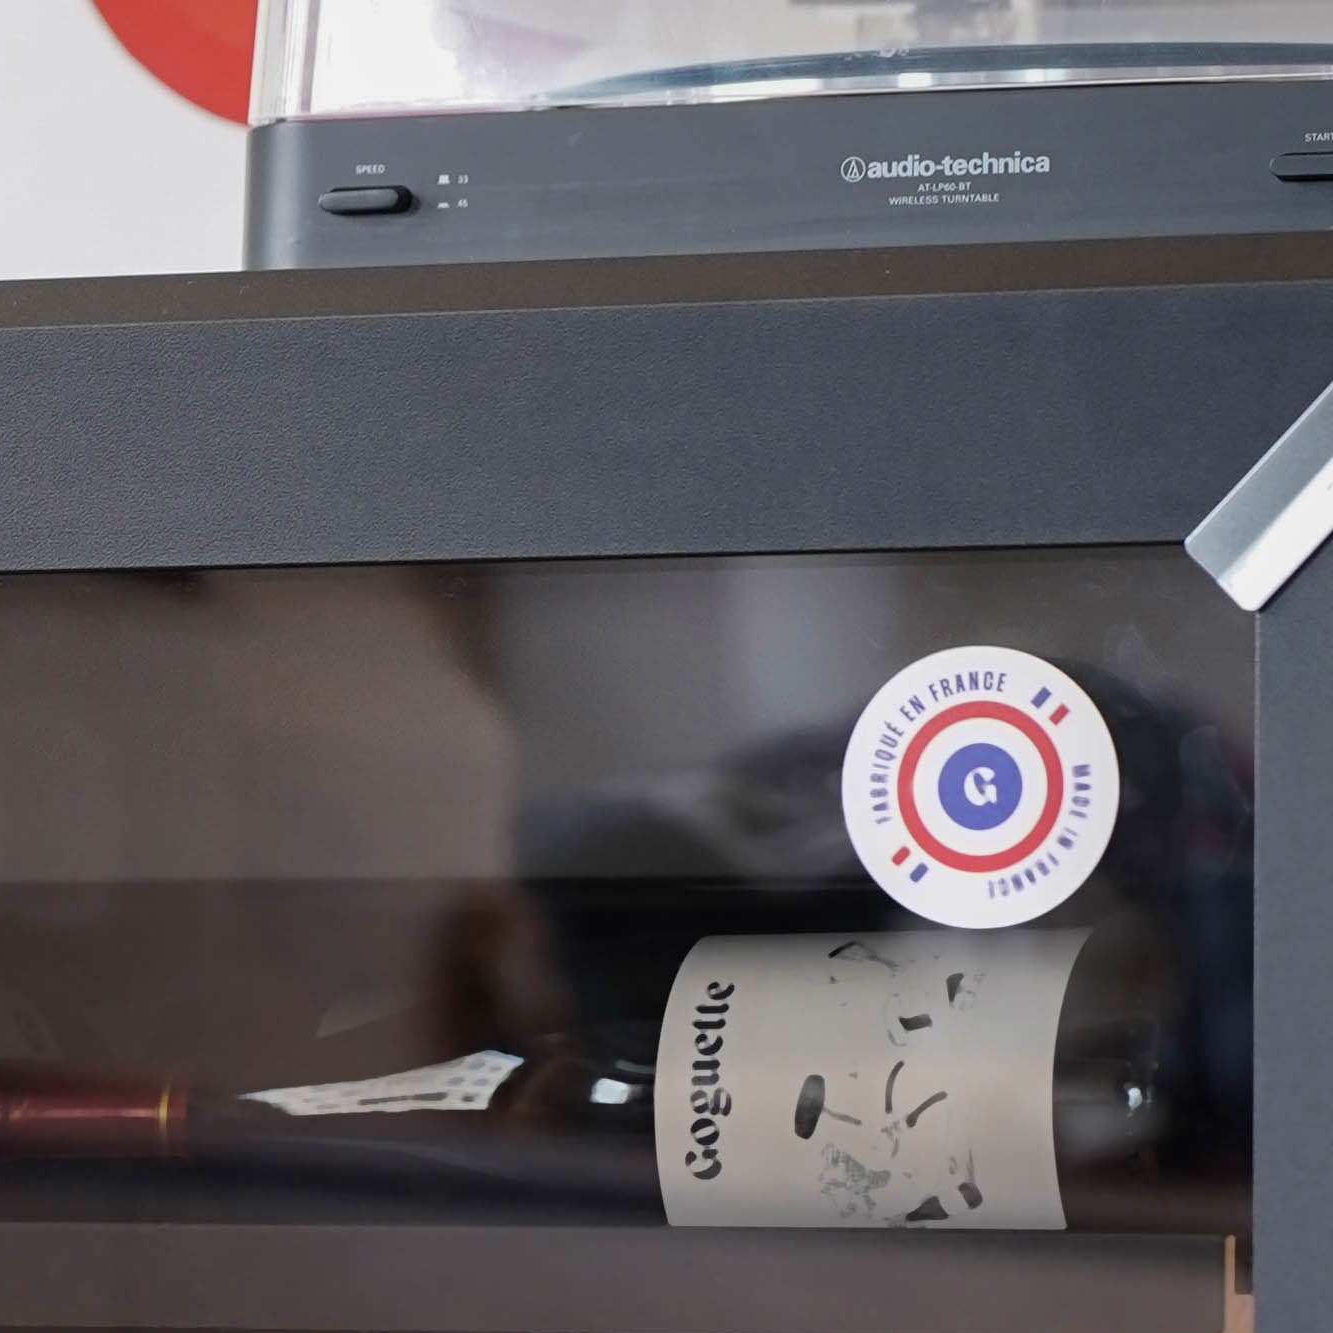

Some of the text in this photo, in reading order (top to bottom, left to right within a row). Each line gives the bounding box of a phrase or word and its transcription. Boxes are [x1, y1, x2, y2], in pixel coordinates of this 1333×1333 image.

[355, 164, 386, 175] SPEED
[866, 151, 1051, 179] audio-technica
[888, 193, 1000, 206] WIRELESS TURNTABLE
[899, 695, 926, 722] EN
[929, 670, 1008, 702] FRANCE
[963, 766, 998, 807] G
[684, 980, 735, 1180] Goguette
